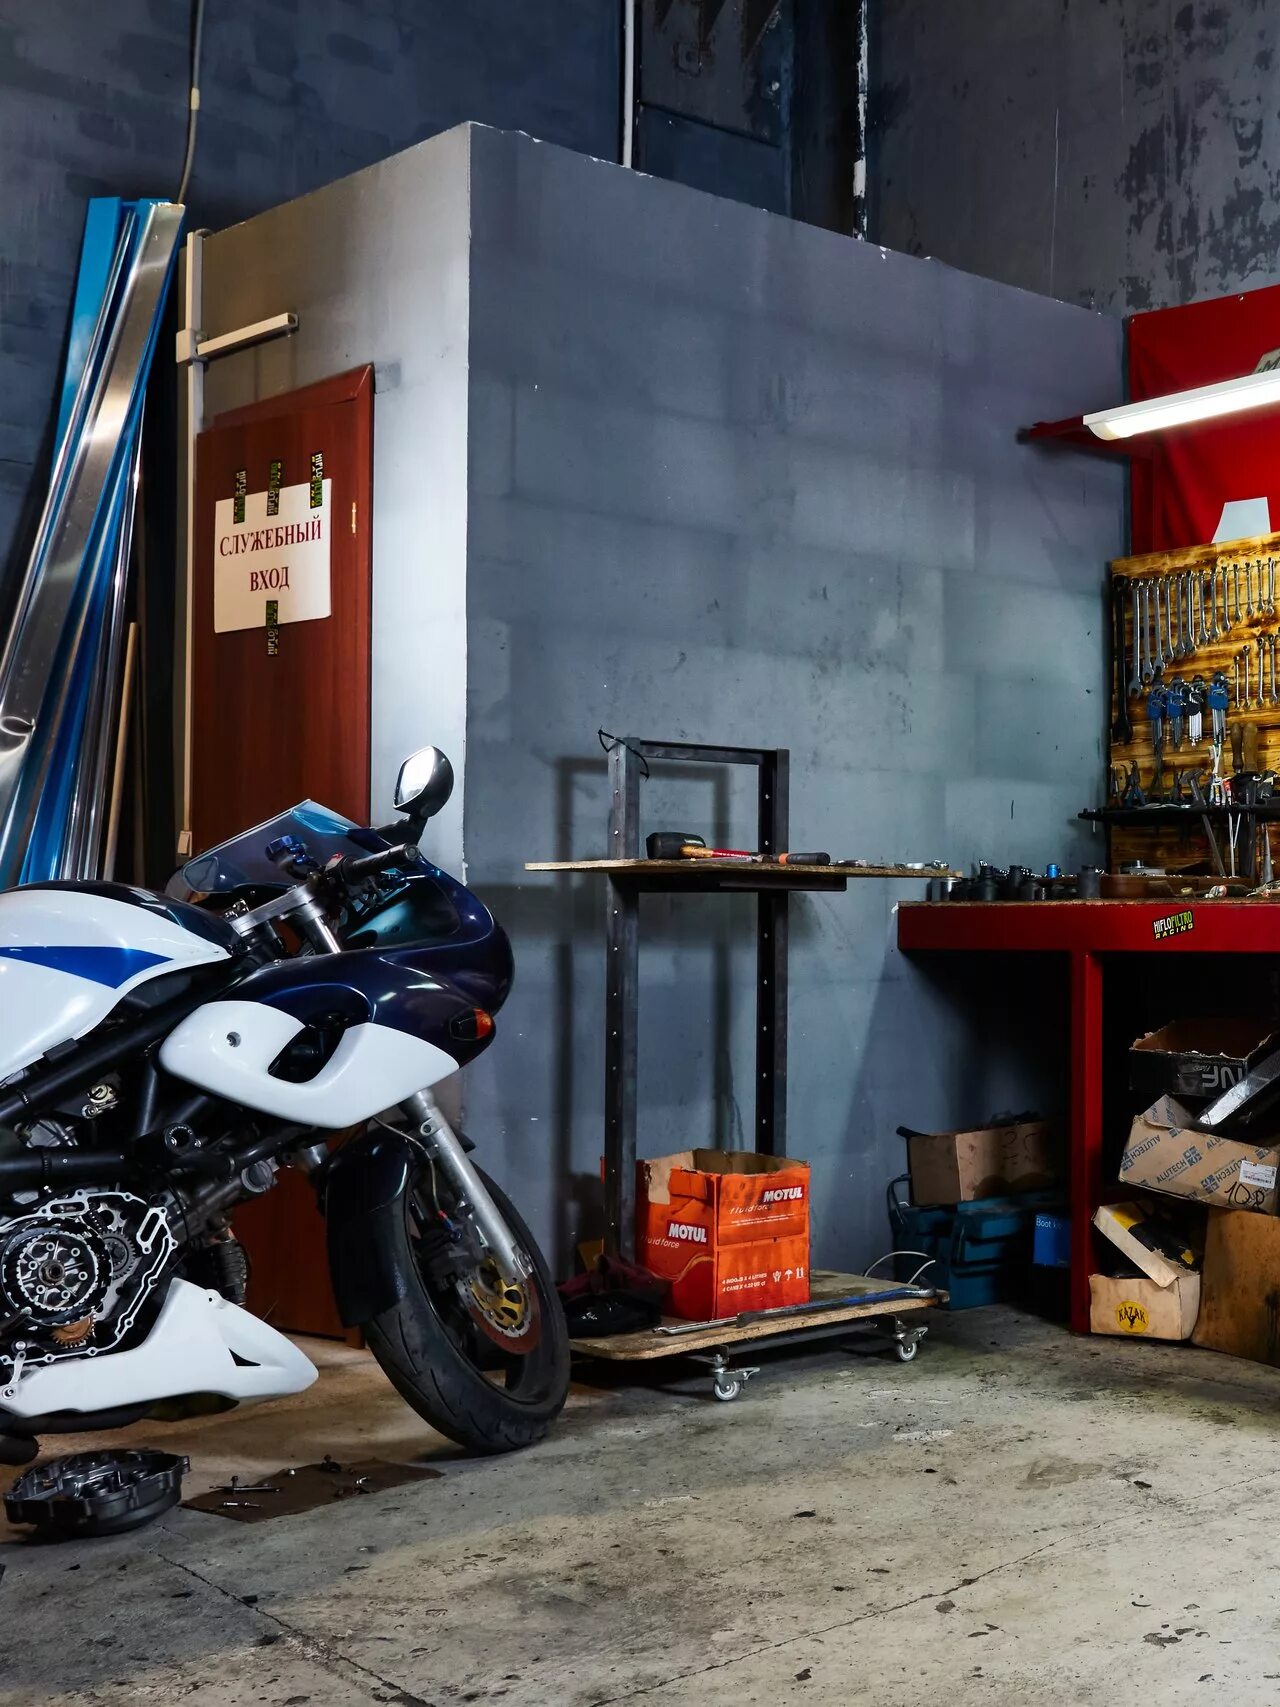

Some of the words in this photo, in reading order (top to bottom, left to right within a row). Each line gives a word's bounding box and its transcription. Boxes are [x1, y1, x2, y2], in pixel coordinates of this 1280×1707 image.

[220, 514, 322, 557] СЛУЖЕБНЫЙ
[250, 566, 290, 592] ВХОД
[1153, 911, 1193, 933] HIFLOFILTRO
[1155, 923, 1194, 940] RACING
[1131, 1135, 1161, 1159] ALUTECH
[1156, 1160, 1187, 1184] ALUTECH
[764, 1186, 803, 1203] MOTUL
[1036, 1216, 1052, 1228] Boot
[668, 1223, 707, 1243] MOTUL
[1118, 1306, 1146, 1324] KAZAK
